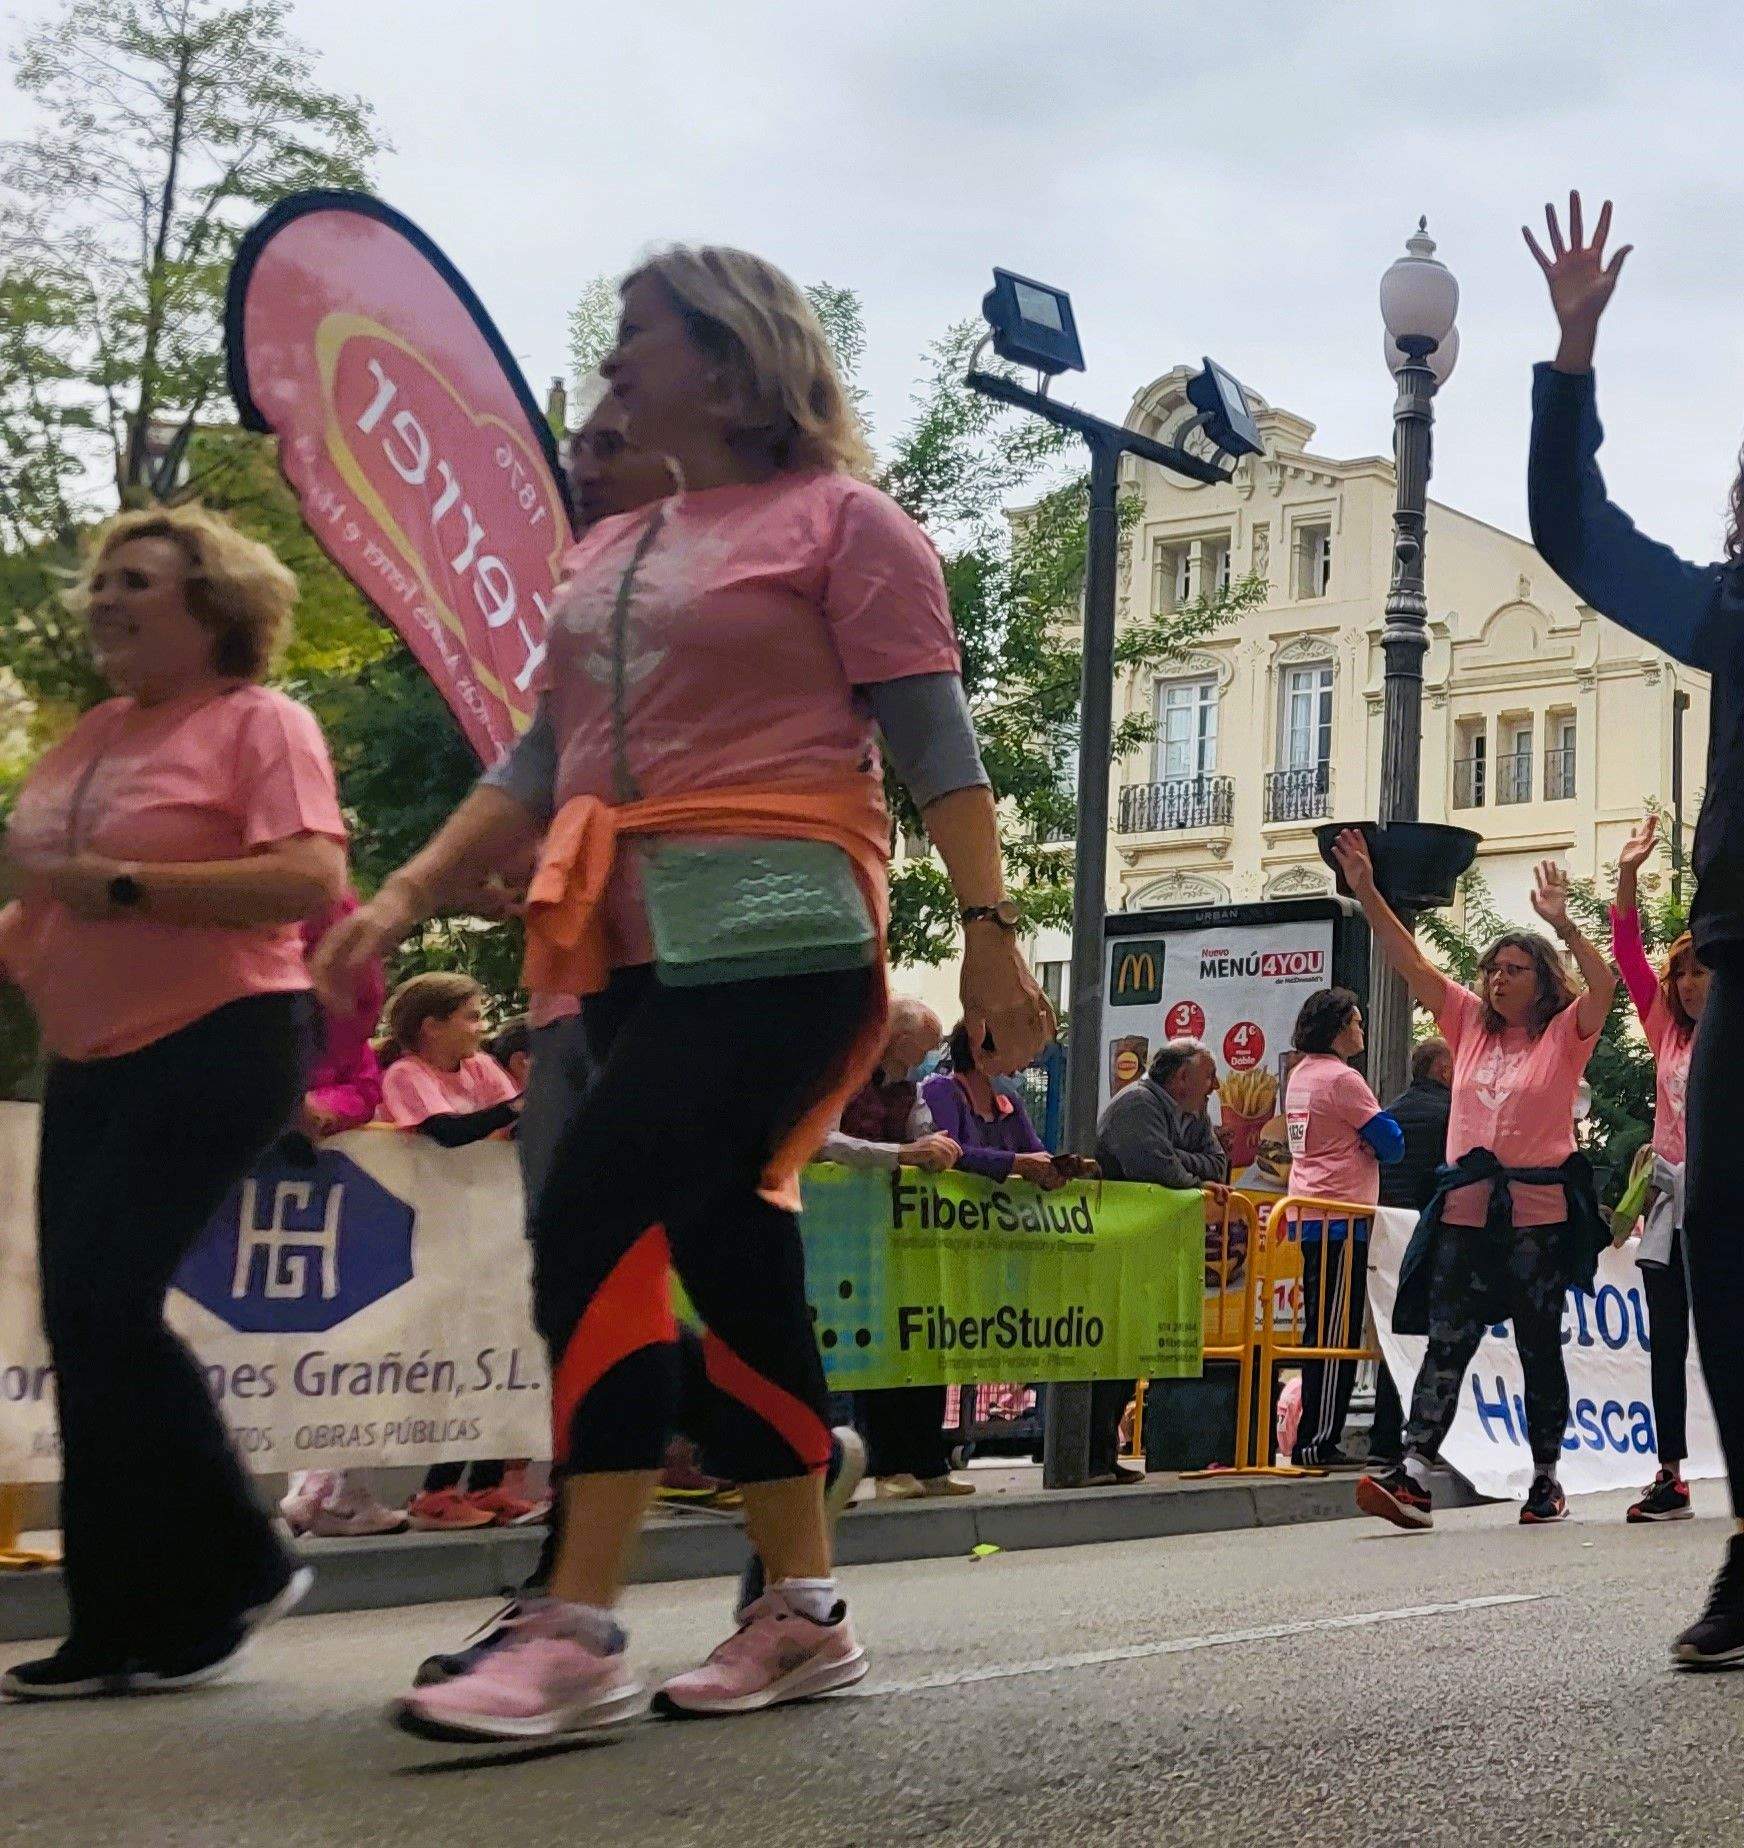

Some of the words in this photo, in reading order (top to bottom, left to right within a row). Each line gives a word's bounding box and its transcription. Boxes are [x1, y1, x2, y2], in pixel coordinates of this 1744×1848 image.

[1201, 948, 1230, 958] Nuevo
[891, 1184, 1095, 1235] FiberSalud
[897, 1304, 1105, 1352] FiberStudio
[472, 1347, 542, 1391] S.L.
[294, 1423, 376, 1451] OBRAS
[383, 1416, 482, 1447] PÚBLICAS
